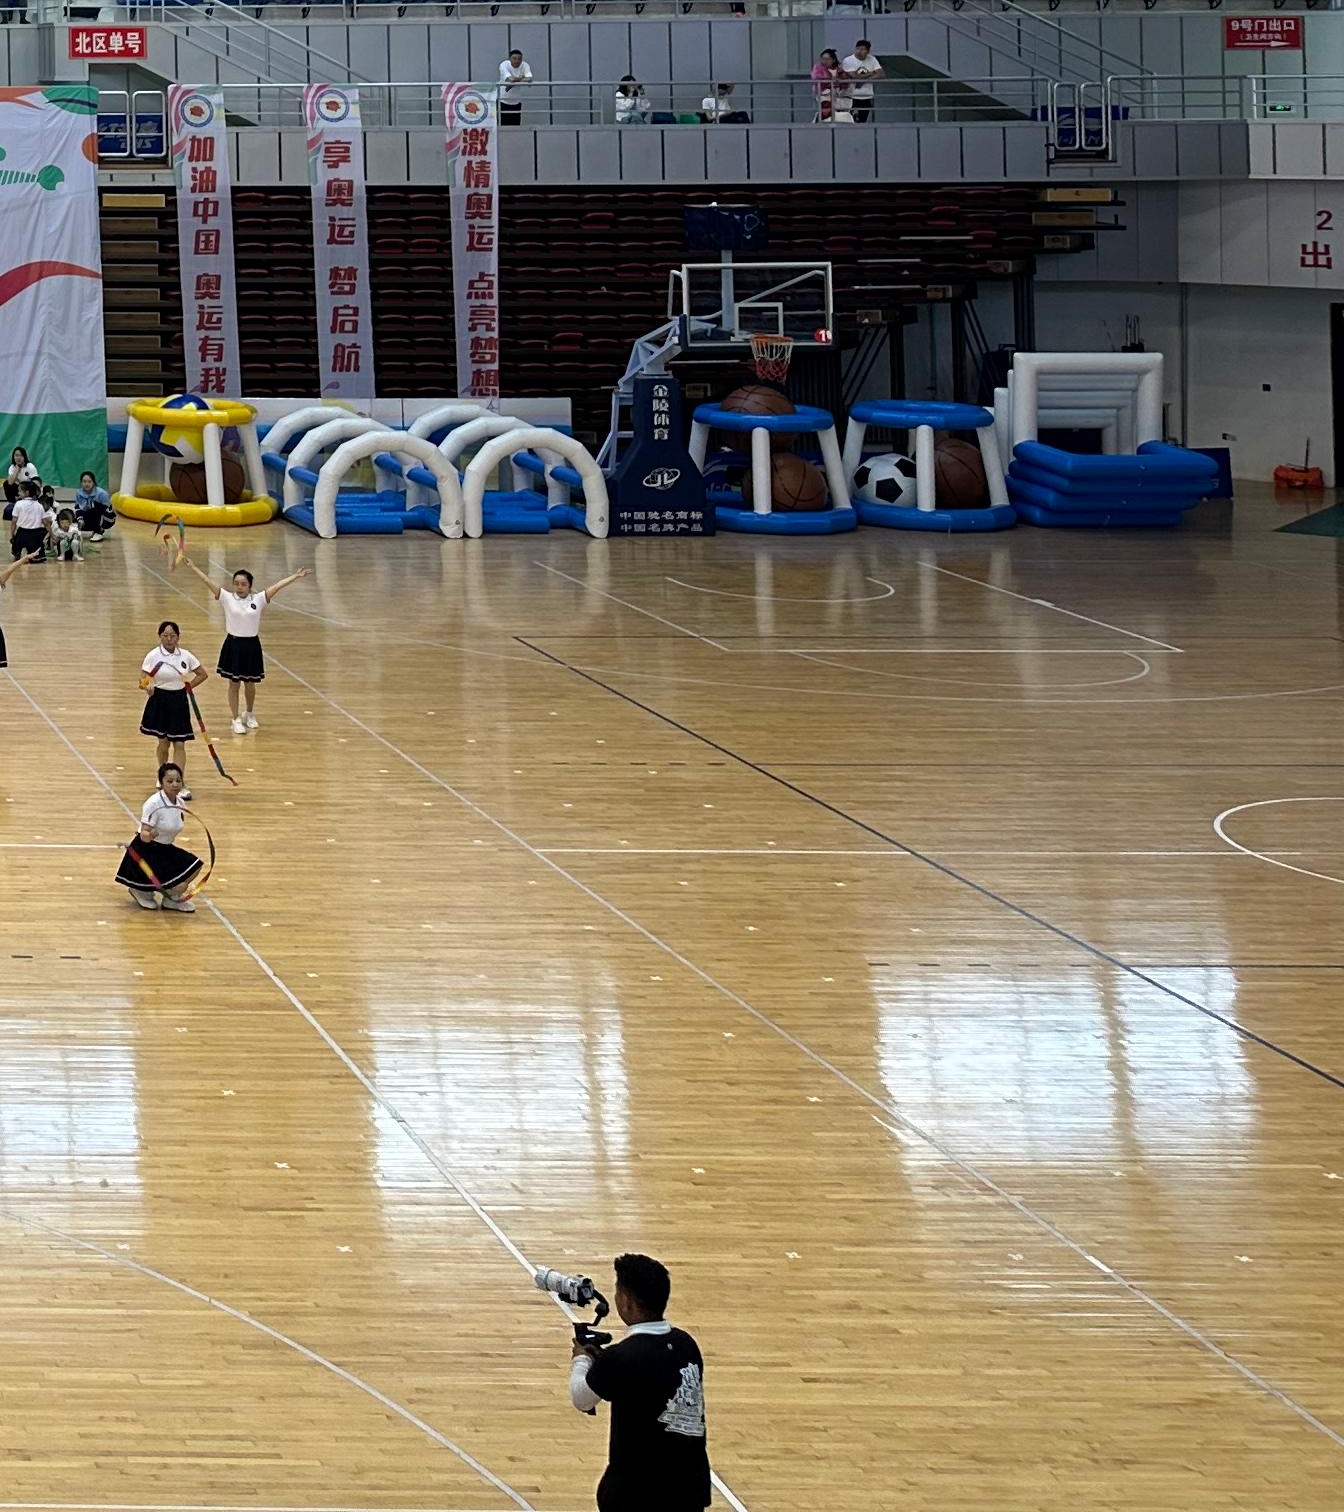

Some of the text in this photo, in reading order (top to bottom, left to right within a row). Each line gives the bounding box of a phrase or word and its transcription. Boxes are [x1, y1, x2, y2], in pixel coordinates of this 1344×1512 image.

[75, 32, 141, 54] 北区单号
[1231, 19, 1295, 31] 9号门出口
[188, 136, 221, 255] 加油中国
[322, 140, 356, 245] 享奥运
[461, 128, 495, 252] 激情奥运
[1316, 210, 1334, 230] 2
[1300, 241, 1332, 269] 出
[194, 273, 227, 393] 奥运有我
[328, 266, 362, 373] 梦启航
[466, 272, 500, 397] 点亮梦想
